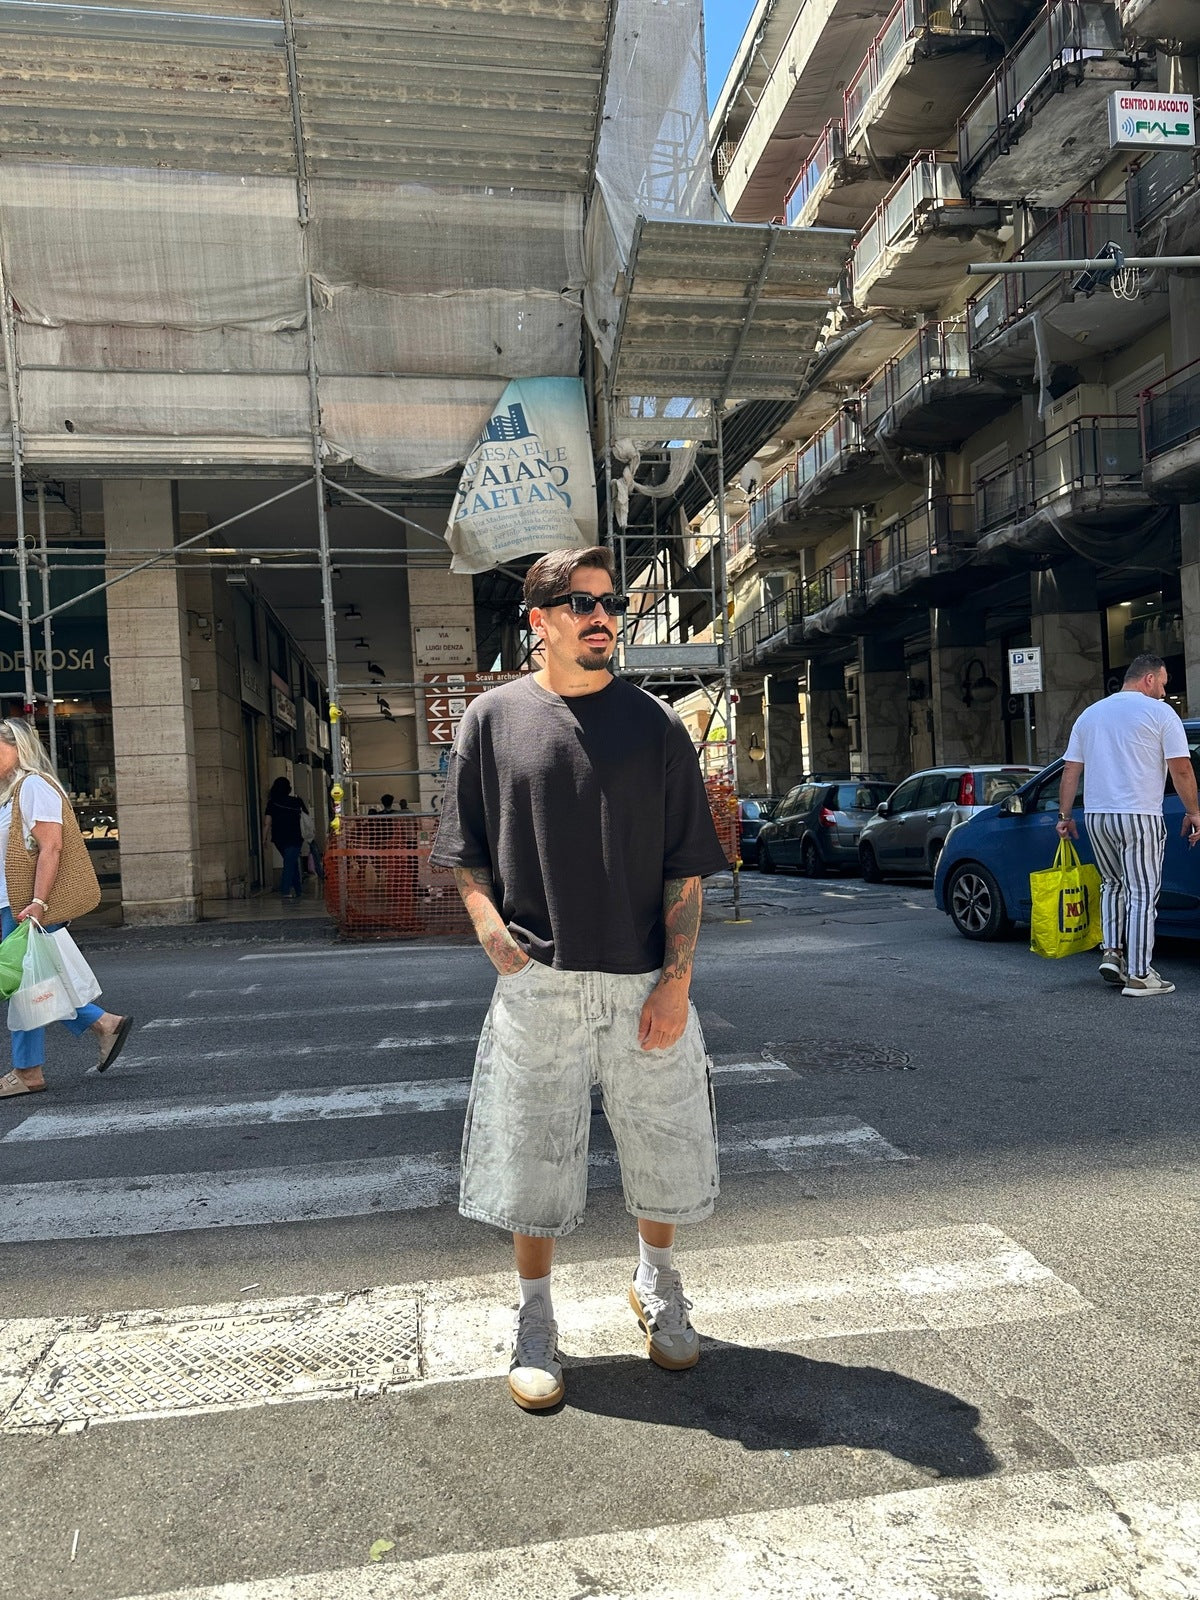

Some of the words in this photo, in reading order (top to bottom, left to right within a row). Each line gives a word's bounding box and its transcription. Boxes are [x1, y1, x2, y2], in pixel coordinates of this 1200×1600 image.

[1120, 98, 1148, 111] CENTRO
[1149, 99, 1156, 111] DI
[1158, 100, 1189, 113] ASCOLTO
[475, 673, 494, 682] Scavi
